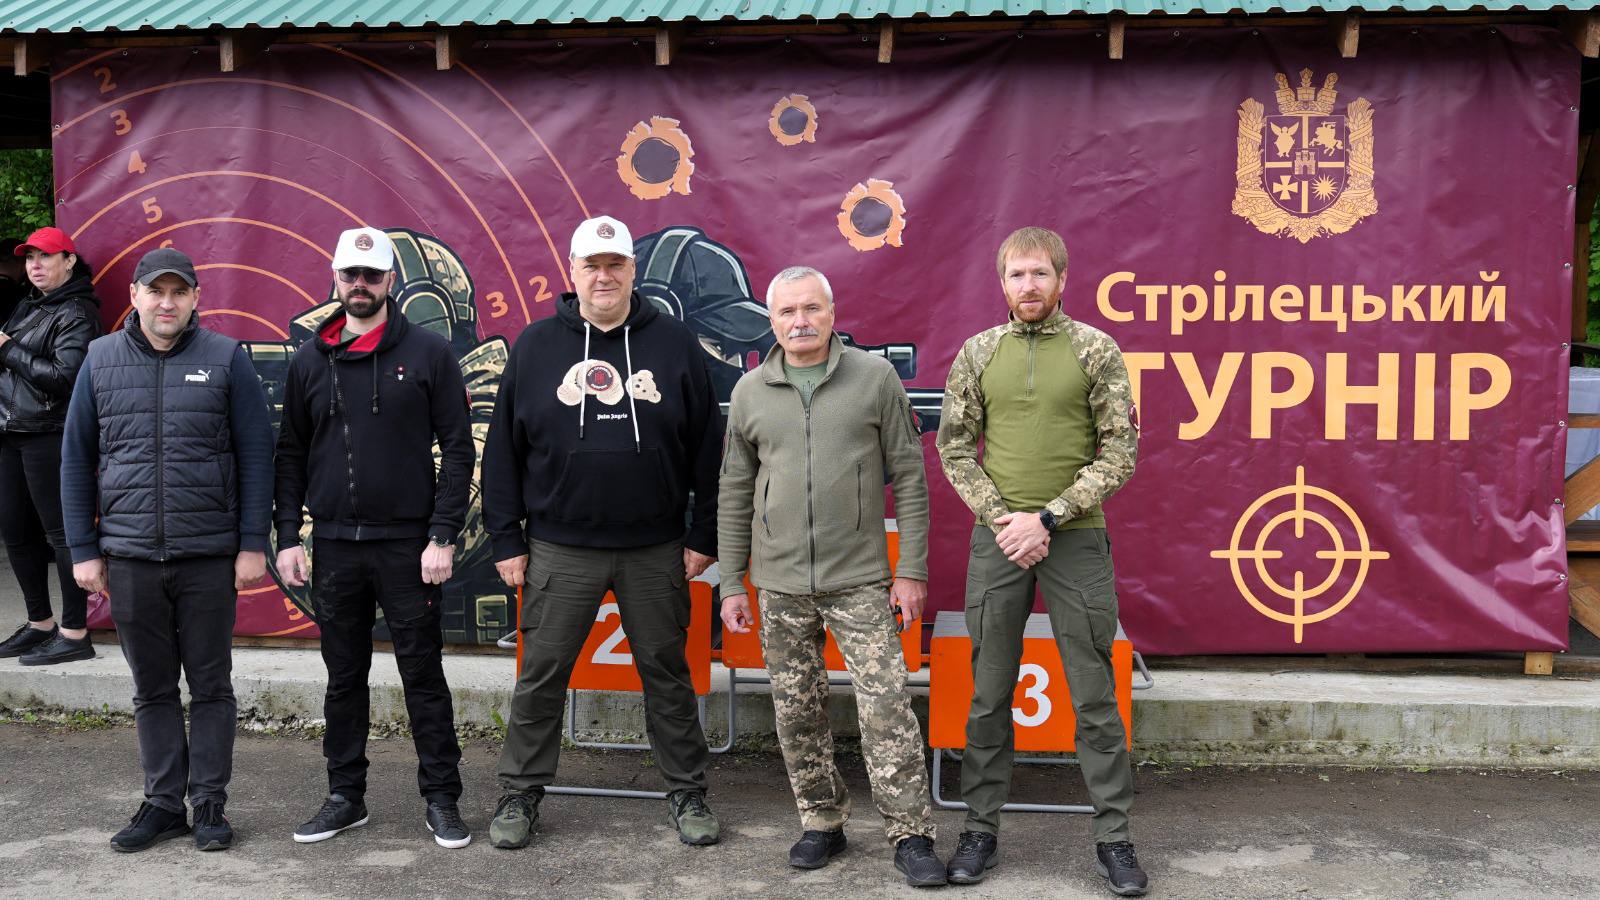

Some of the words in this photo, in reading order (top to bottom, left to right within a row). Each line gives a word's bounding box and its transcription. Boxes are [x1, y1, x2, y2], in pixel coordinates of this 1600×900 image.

[94, 66, 117, 94] 2
[110, 109, 132, 136] 3
[127, 150, 147, 174] 4
[142, 197, 163, 224] 5
[528, 275, 553, 303] 2
[1096, 270, 1507, 336] Стрілецький
[485, 291, 509, 318] 3
[591, 602, 633, 665] 2
[1011, 663, 1052, 727] 3
